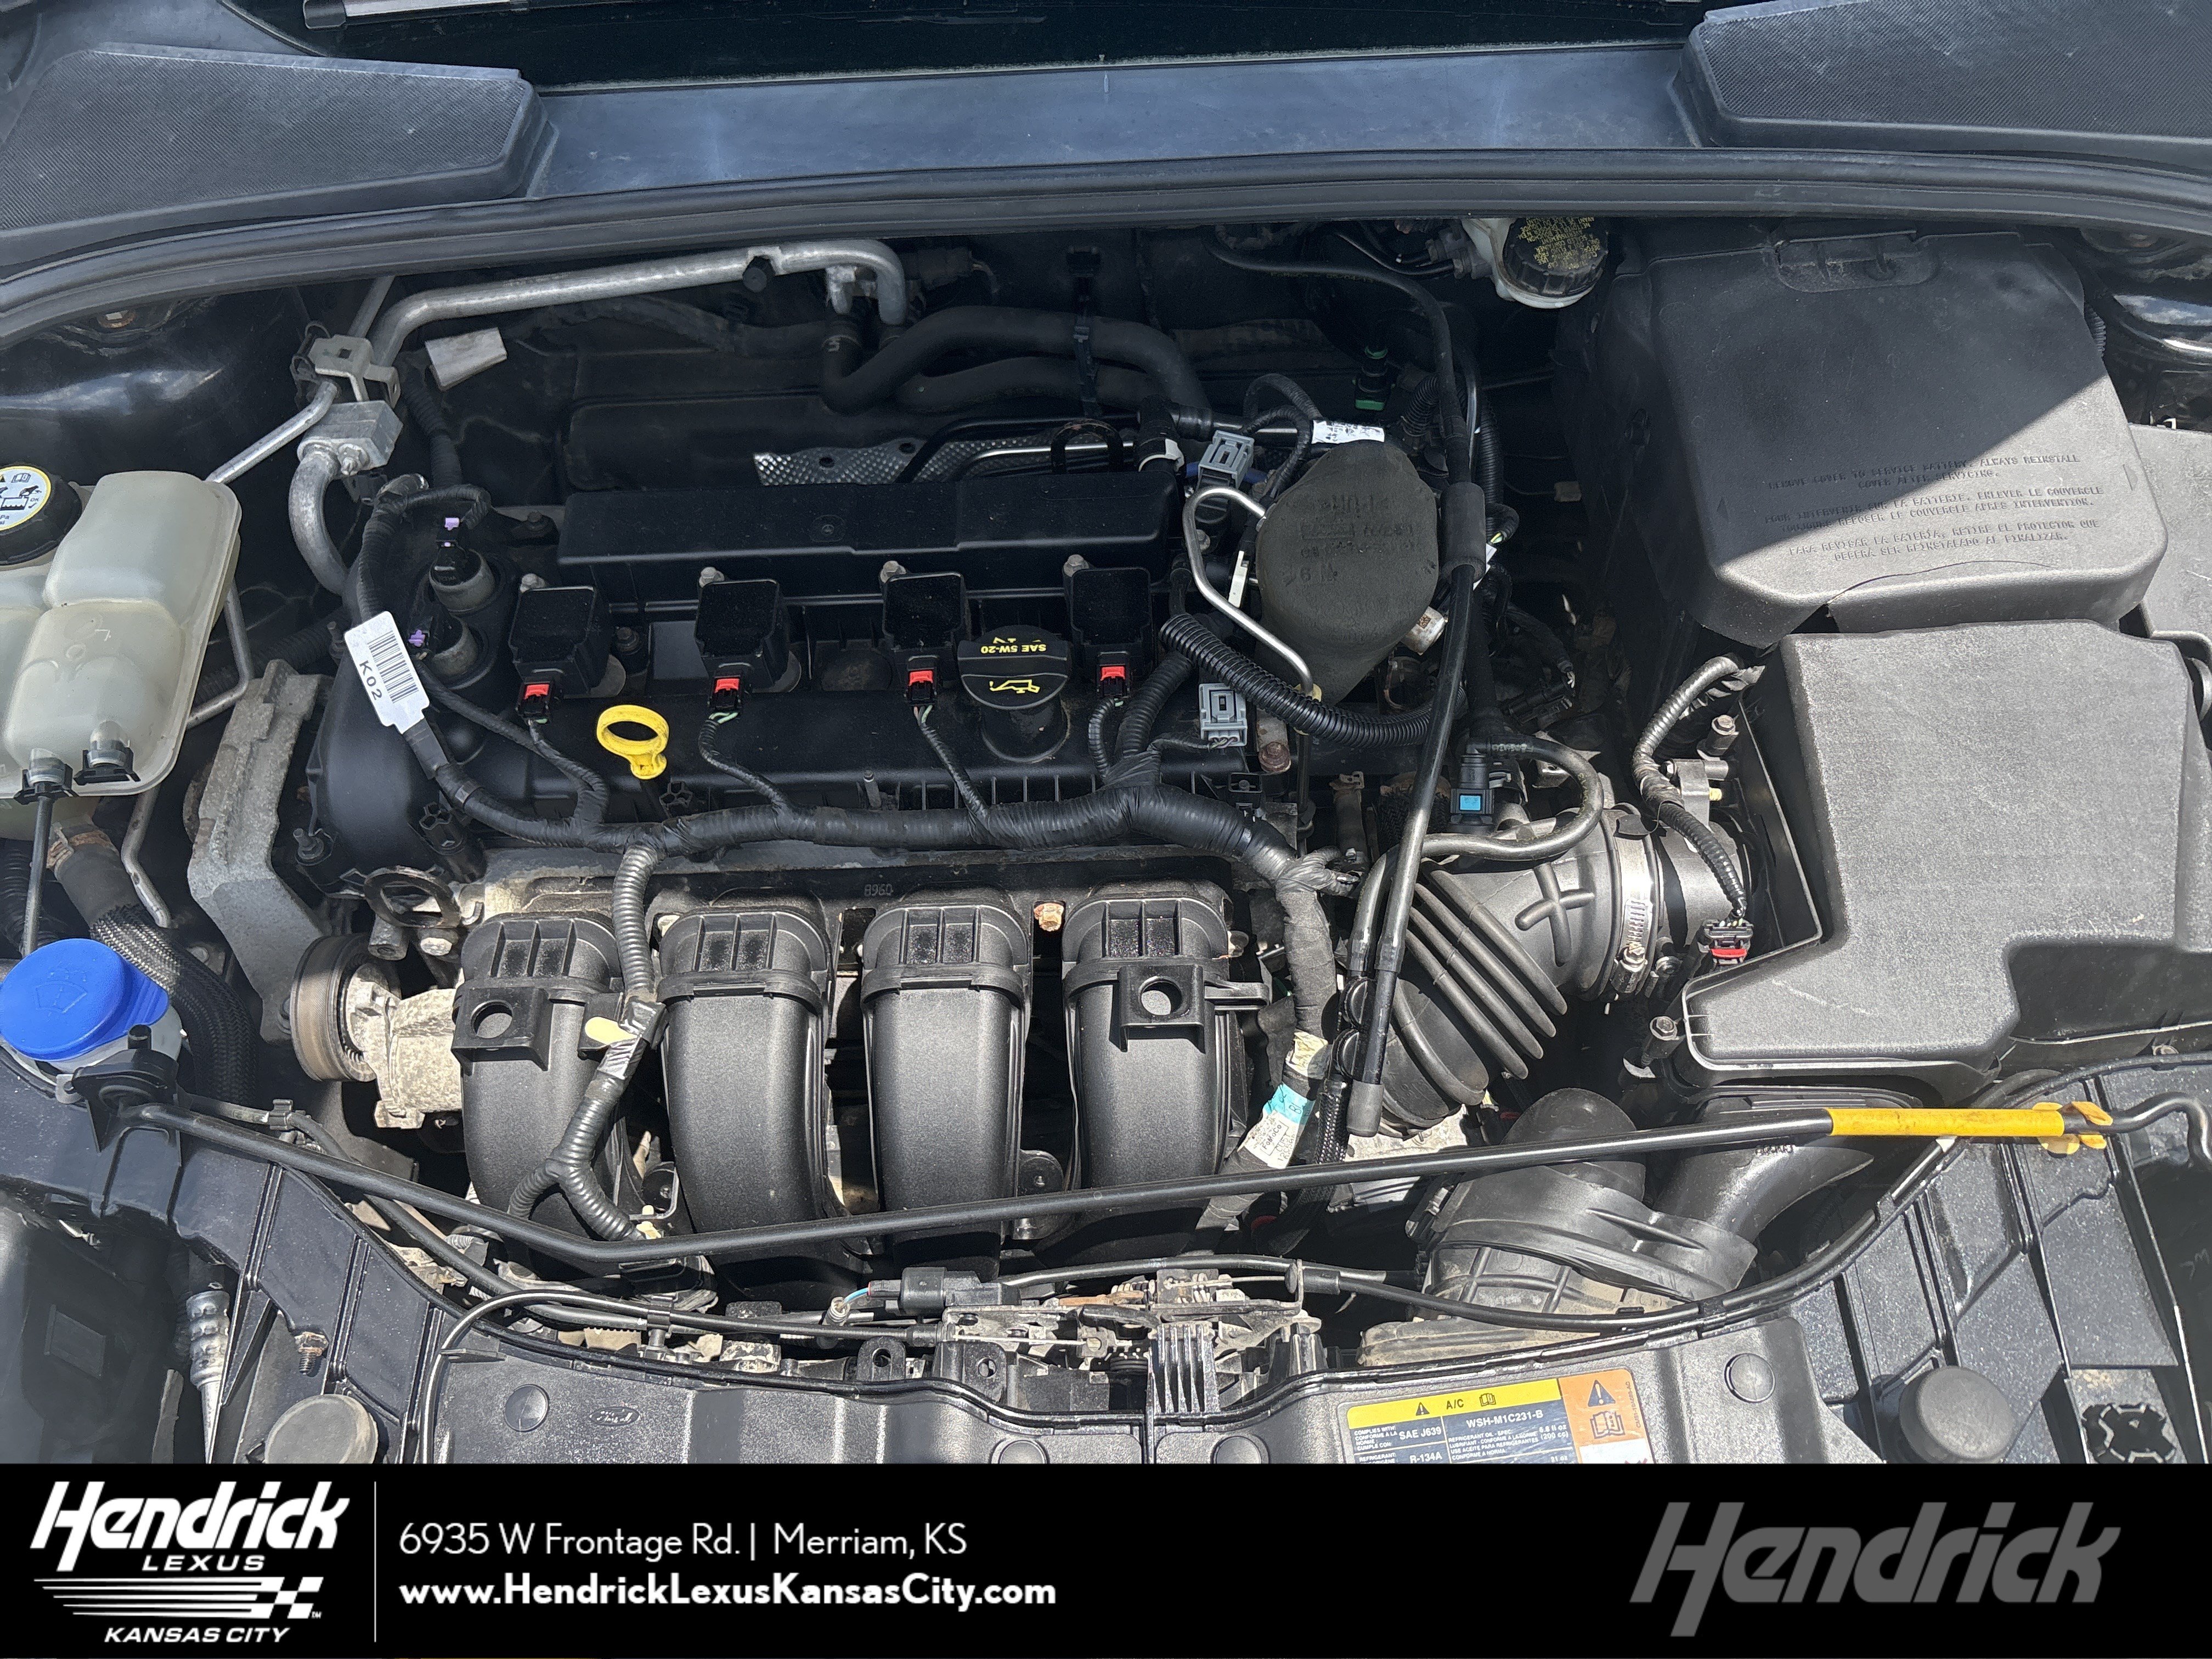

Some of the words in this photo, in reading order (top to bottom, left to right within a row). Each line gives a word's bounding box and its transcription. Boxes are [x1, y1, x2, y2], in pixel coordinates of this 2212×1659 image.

[1980, 457, 2018, 466] ALWAYS
[2023, 455, 2080, 464] REINSTALL
[1869, 502, 1887, 510] SUR
[1913, 494, 1971, 505] BATTERIE.
[1977, 489, 2023, 499] ENLEVER
[2047, 487, 2103, 495] COUVERCLE
[1839, 514, 1884, 526] REPOSER
[1910, 505, 1970, 516] COUVERCLE
[1790, 546, 1817, 556] PARA
[1822, 539, 1868, 551] REVISAR
[1874, 537, 1888, 545] LA
[1953, 526, 1991, 536] RETIRE
[1998, 523, 2012, 532] EL
[2018, 521, 2075, 531] PROTECTOR
[1881, 547, 1901, 555] SER
[1907, 539, 1979, 552] REINSTALADO
[2005, 532, 2068, 543] FINALIZAR.
[981, 645, 1019, 654] 5W-20
[1022, 644, 1047, 653] SAE
[359, 660, 382, 701] K02
[1262, 1124, 1282, 1150] FoMoCo
[1446, 1399, 1464, 1409] A/C
[1466, 1409, 1543, 1428] WSH-M1C231-B
[1399, 1430, 1418, 1440] SAE
[1420, 1426, 1442, 1436] J639
[1449, 1434, 1483, 1442] REFRIGERANT
[1497, 1437, 1538, 1447] REFRIGERANTES
[1410, 1452, 1442, 1463] R-134A
